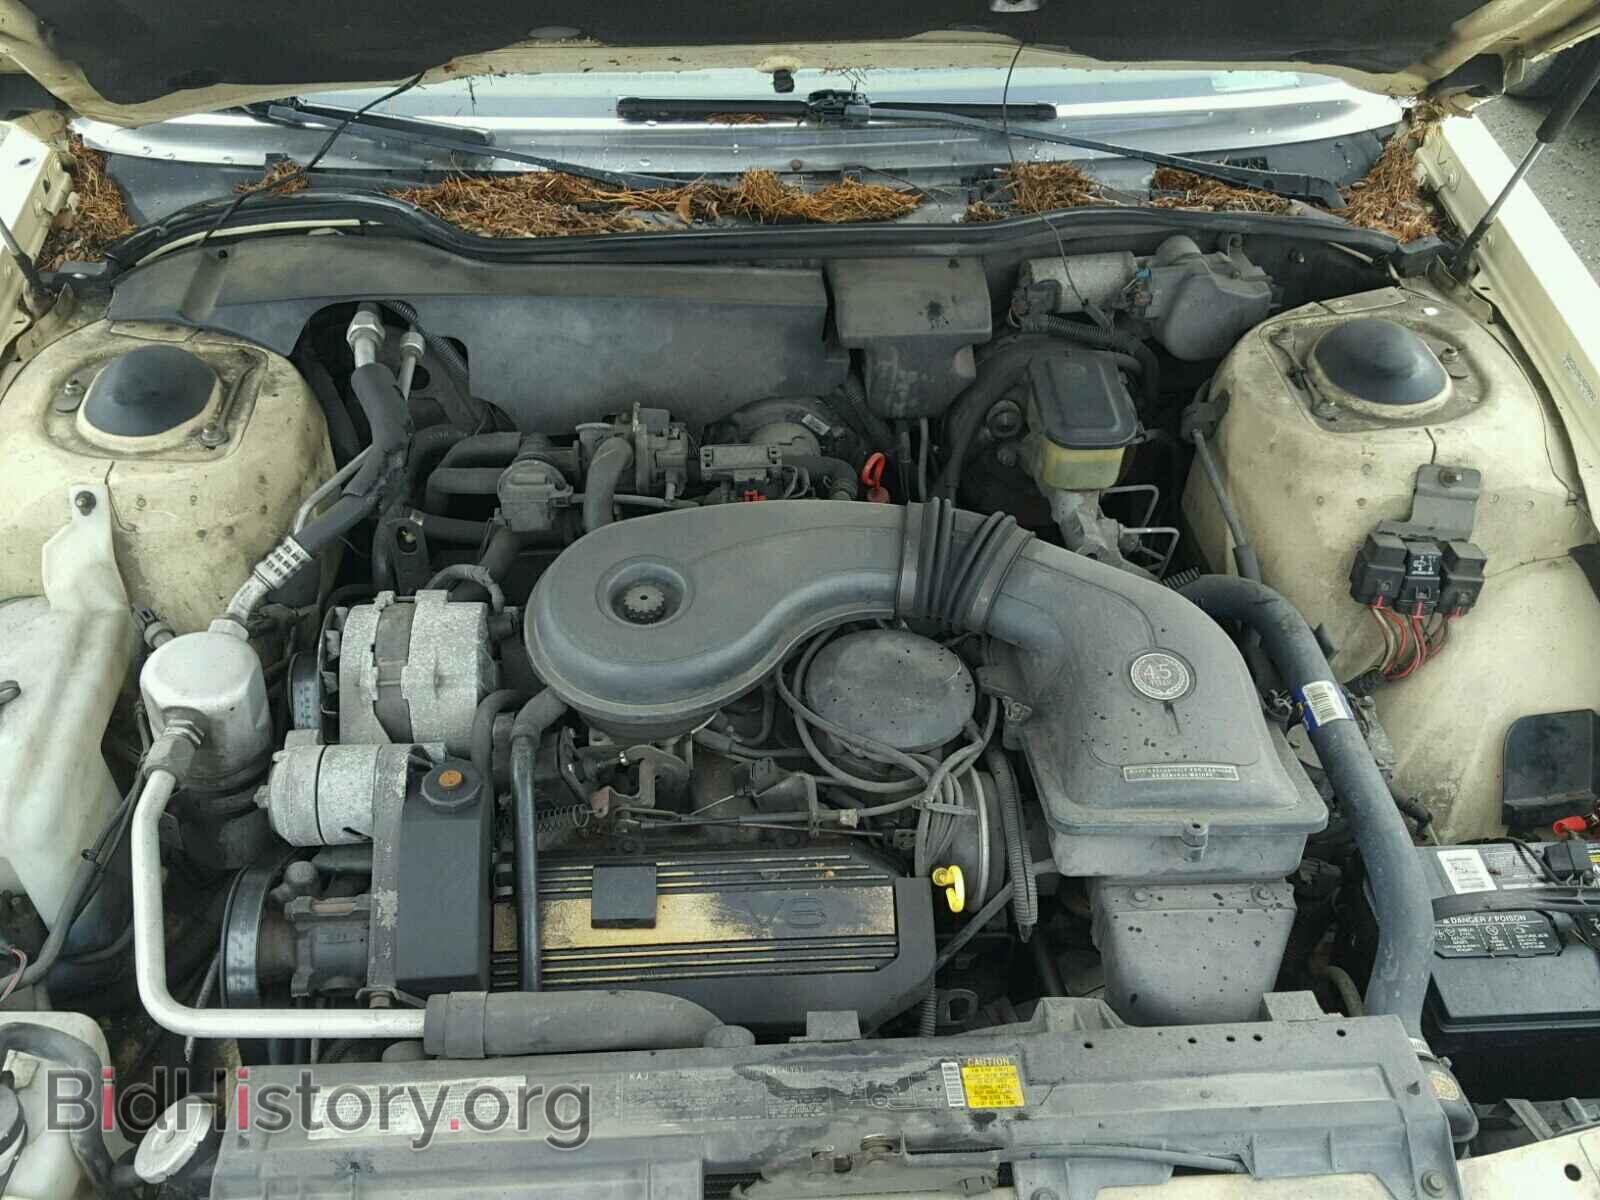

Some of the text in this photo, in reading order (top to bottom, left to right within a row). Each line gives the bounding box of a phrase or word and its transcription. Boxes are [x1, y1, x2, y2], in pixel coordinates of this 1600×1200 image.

[1143, 664, 1172, 680] 4.5
[1494, 914, 1527, 922] POISON
[967, 1055, 1010, 1066] CAUTION
[629, 1071, 650, 1081] KAJ
